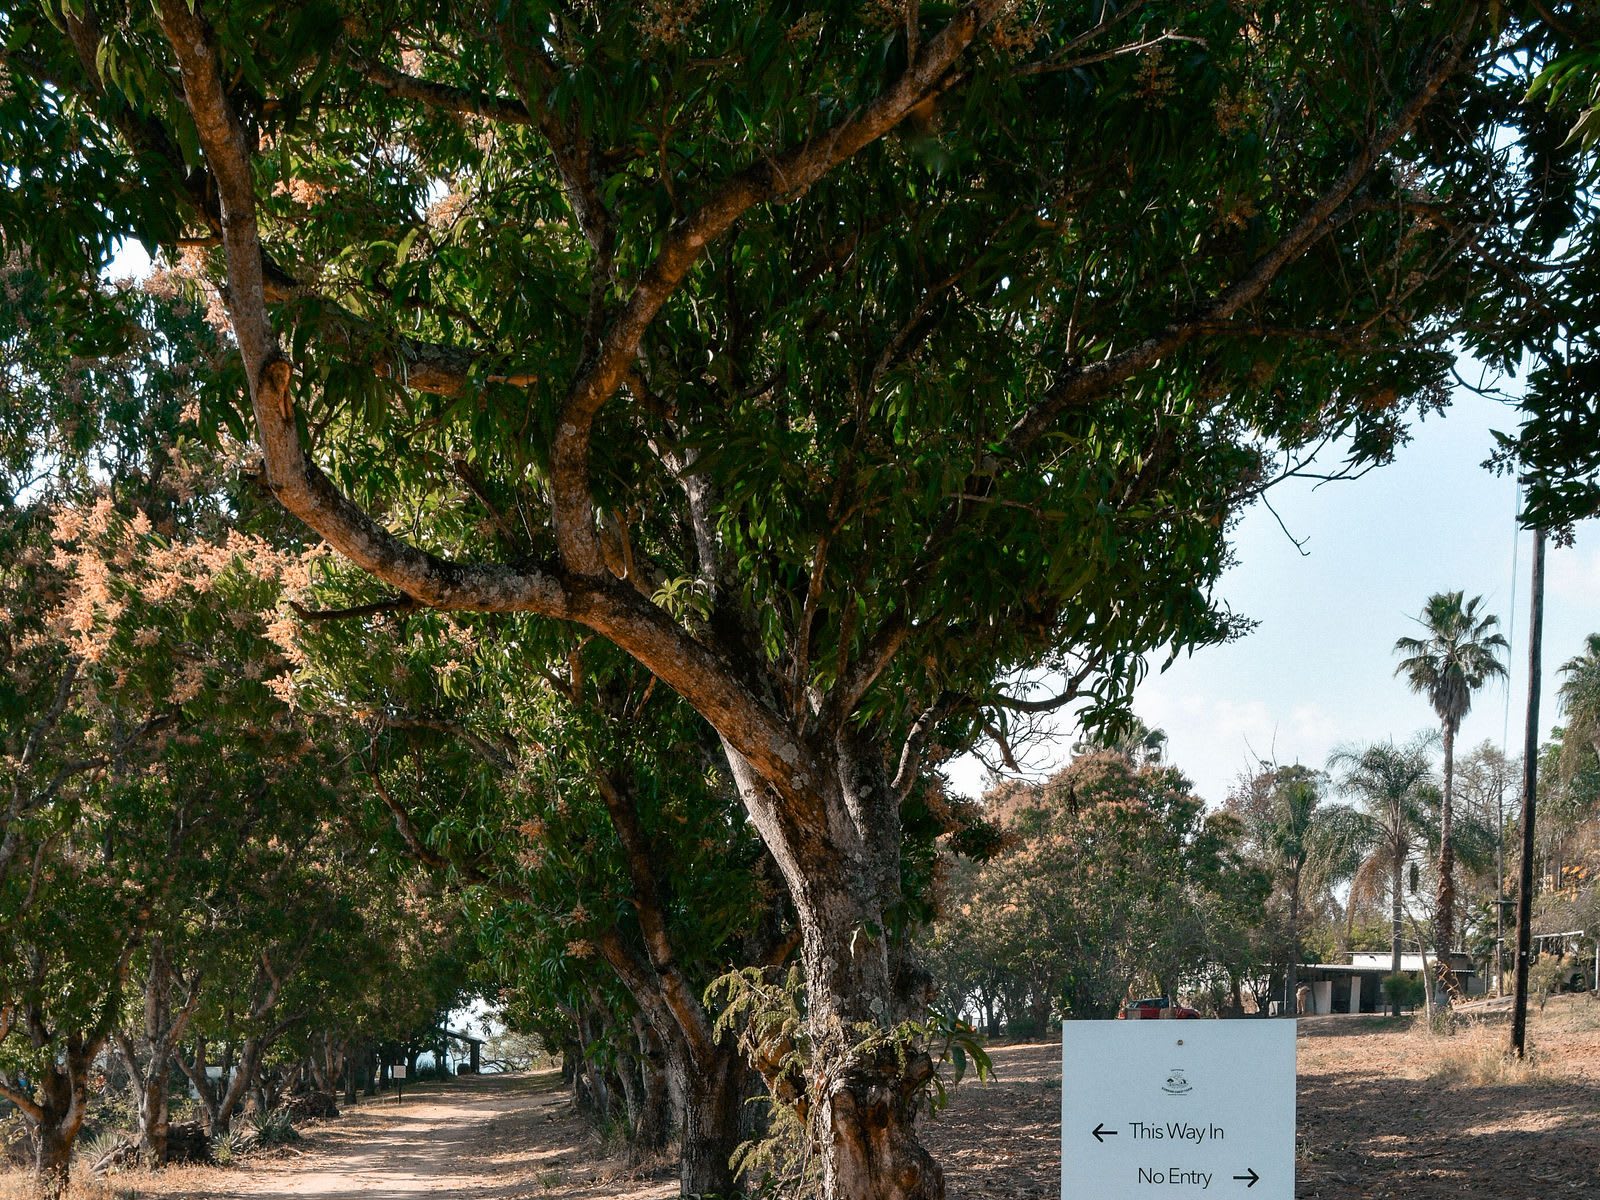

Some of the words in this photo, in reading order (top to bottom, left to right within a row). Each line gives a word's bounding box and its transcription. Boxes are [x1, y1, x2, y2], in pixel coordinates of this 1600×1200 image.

[1128, 1121, 1164, 1140] This
[1166, 1122, 1206, 1144] Way
[1209, 1123, 1225, 1140] In
[1138, 1167, 1165, 1184] No
[1169, 1167, 1213, 1190] Entry
